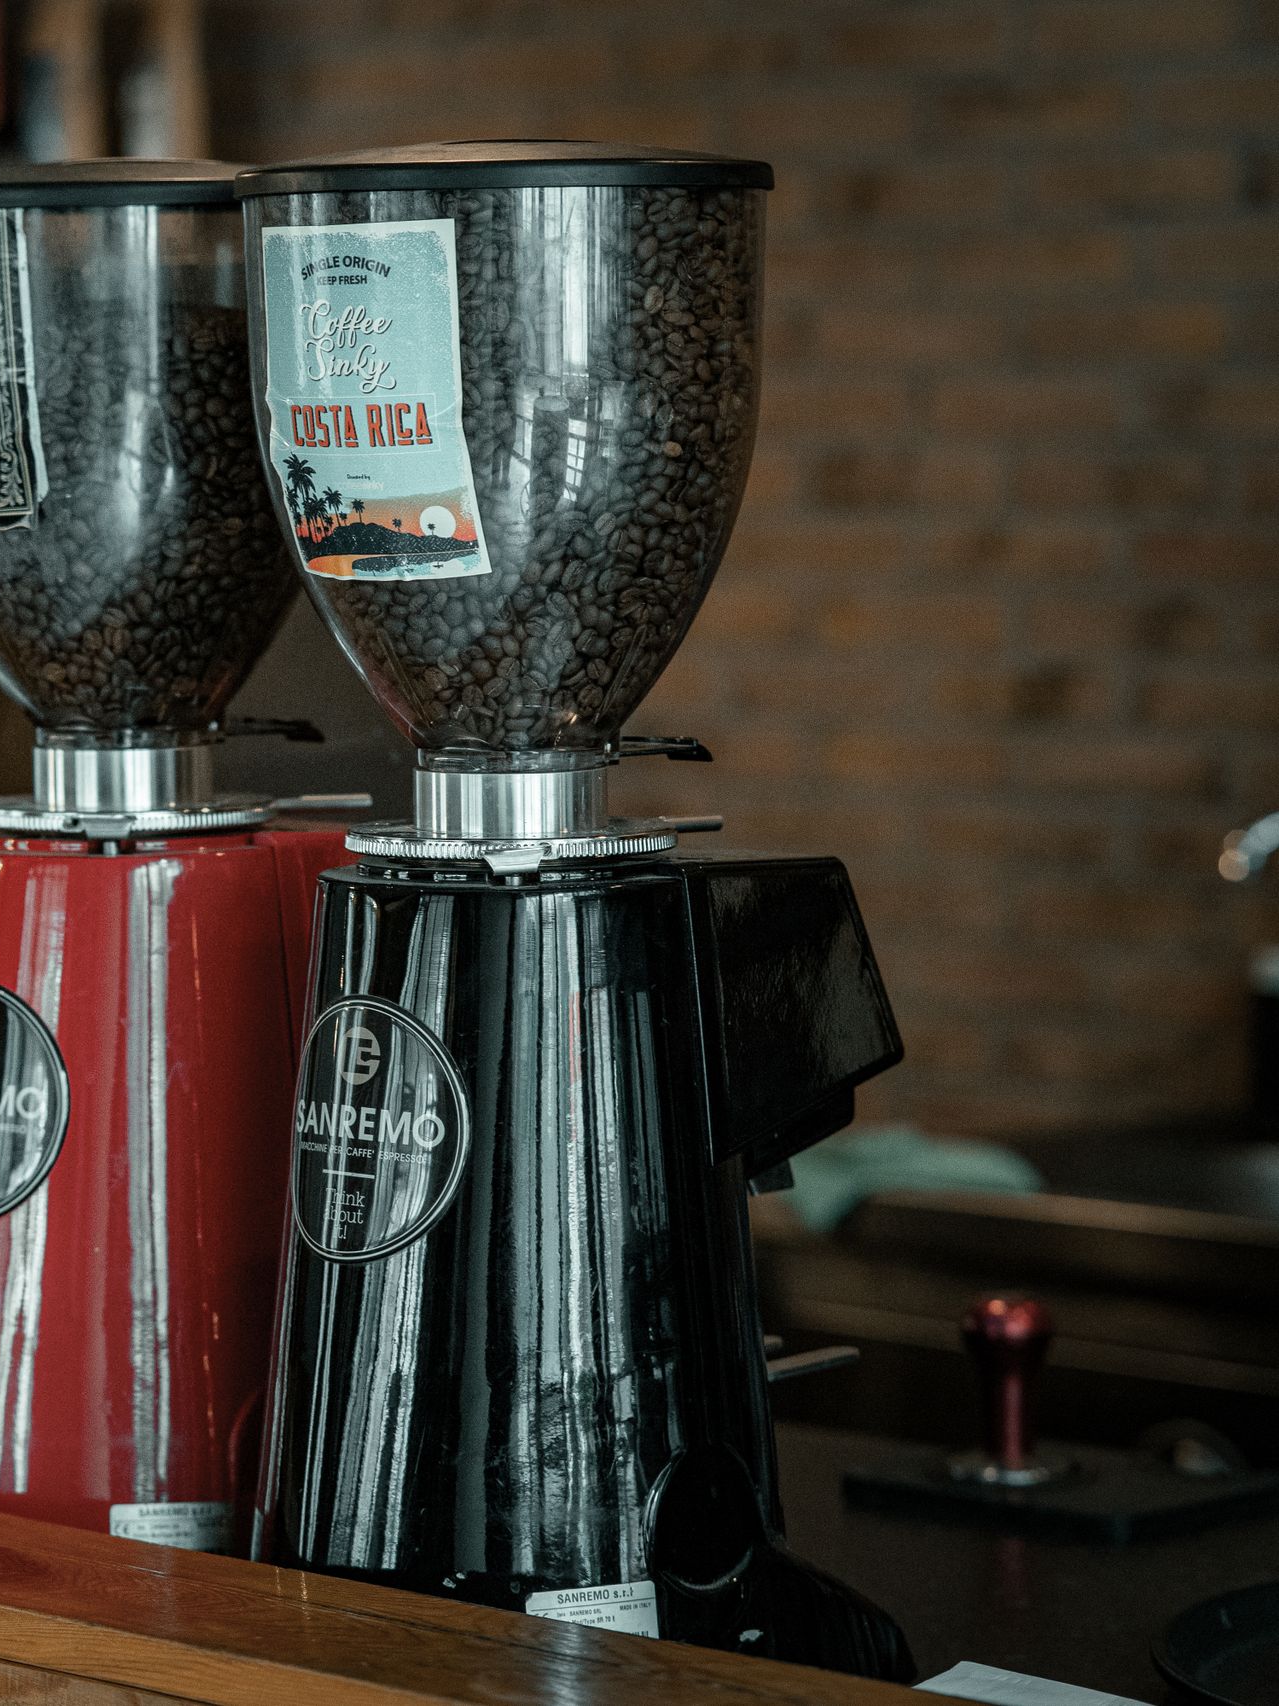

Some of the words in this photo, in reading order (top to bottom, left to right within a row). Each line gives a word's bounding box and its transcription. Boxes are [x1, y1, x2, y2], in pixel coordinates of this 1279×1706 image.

[301, 256, 340, 280] SINGLE
[342, 255, 391, 278] ORIGIN
[317, 276, 337, 285] KEEP
[338, 275, 368, 285] FRESH
[300, 299, 393, 348] Coffee
[305, 337, 397, 394] Sinky
[290, 404, 359, 448] COSTA
[366, 402, 433, 447] RICA
[296, 1099, 445, 1148] SANREMO
[379, 1150, 426, 1164] ESPRESSO
[557, 1589, 610, 1605] SANREMO
